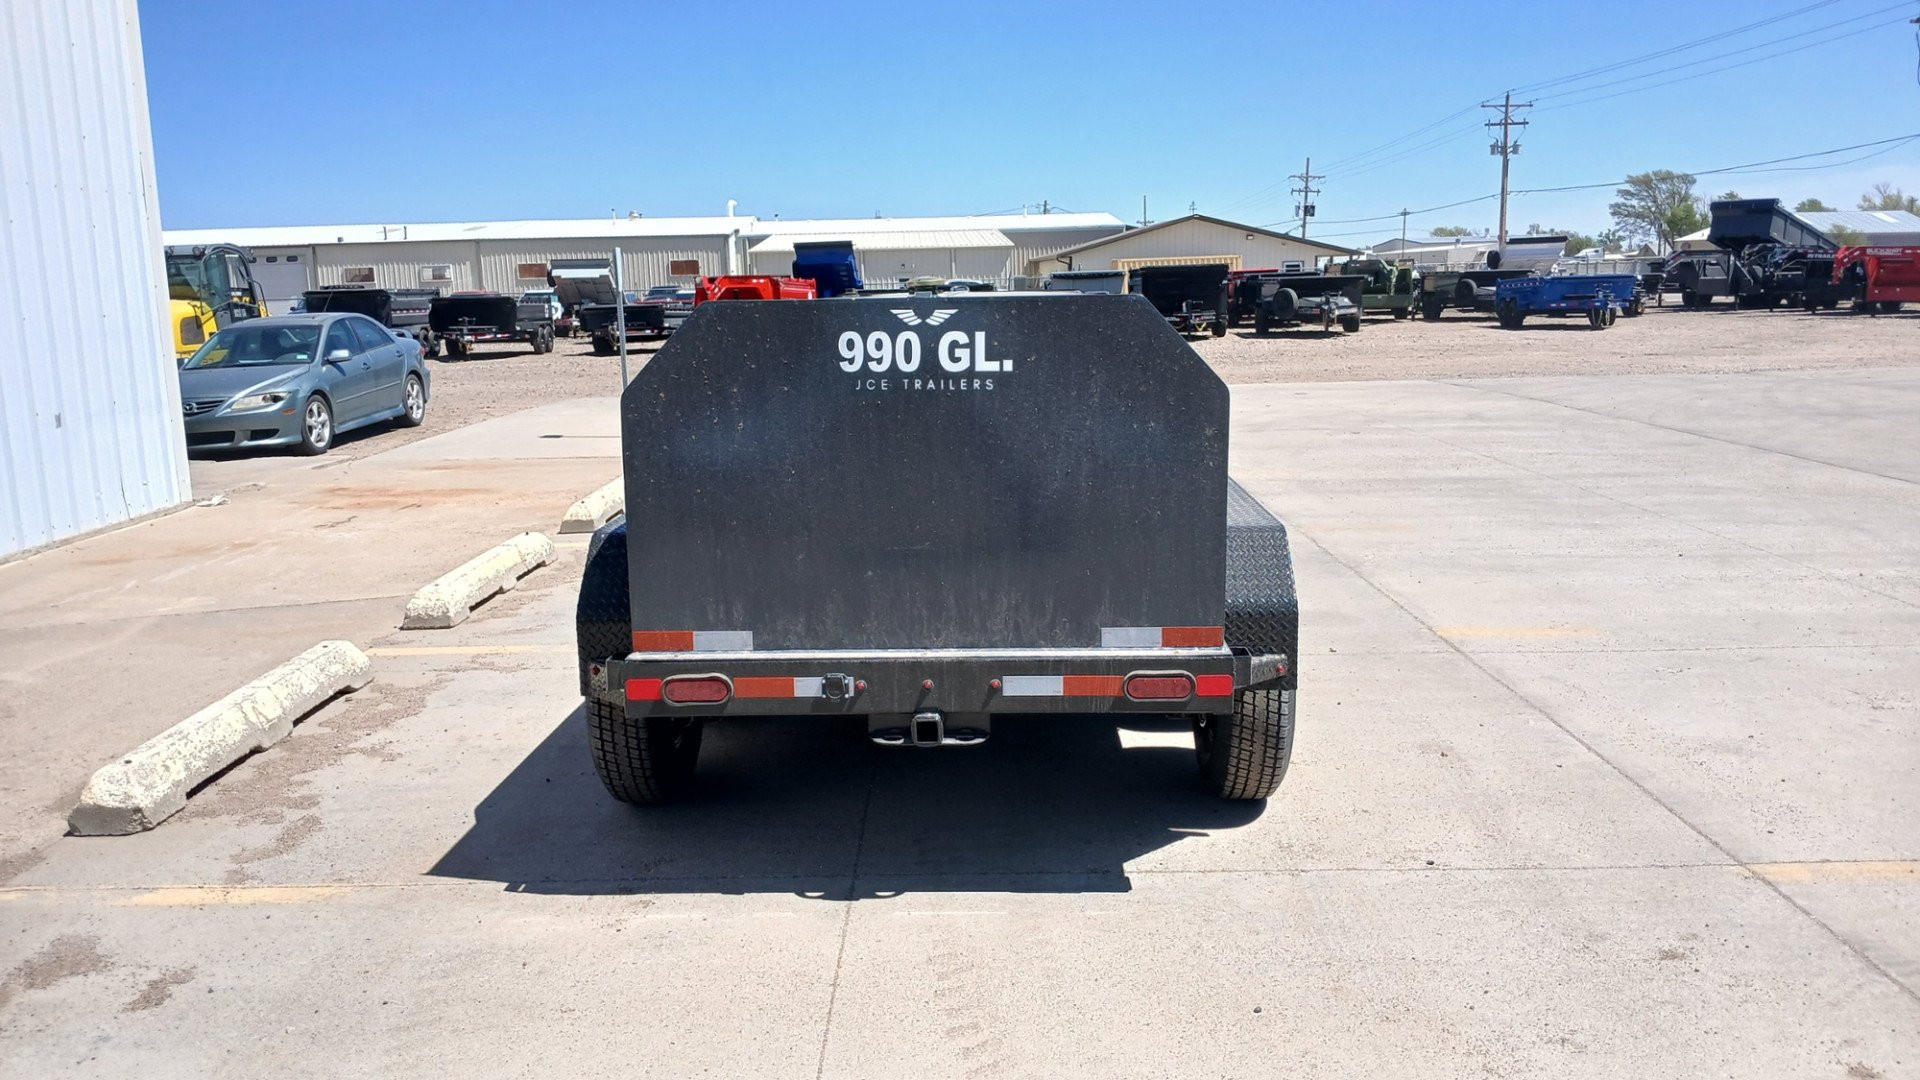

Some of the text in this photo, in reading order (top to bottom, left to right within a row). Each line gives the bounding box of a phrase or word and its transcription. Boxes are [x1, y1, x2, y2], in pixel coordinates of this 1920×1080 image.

[838, 331, 1013, 372] 990 GL.
[855, 379, 994, 390] JCE TRAILERS
